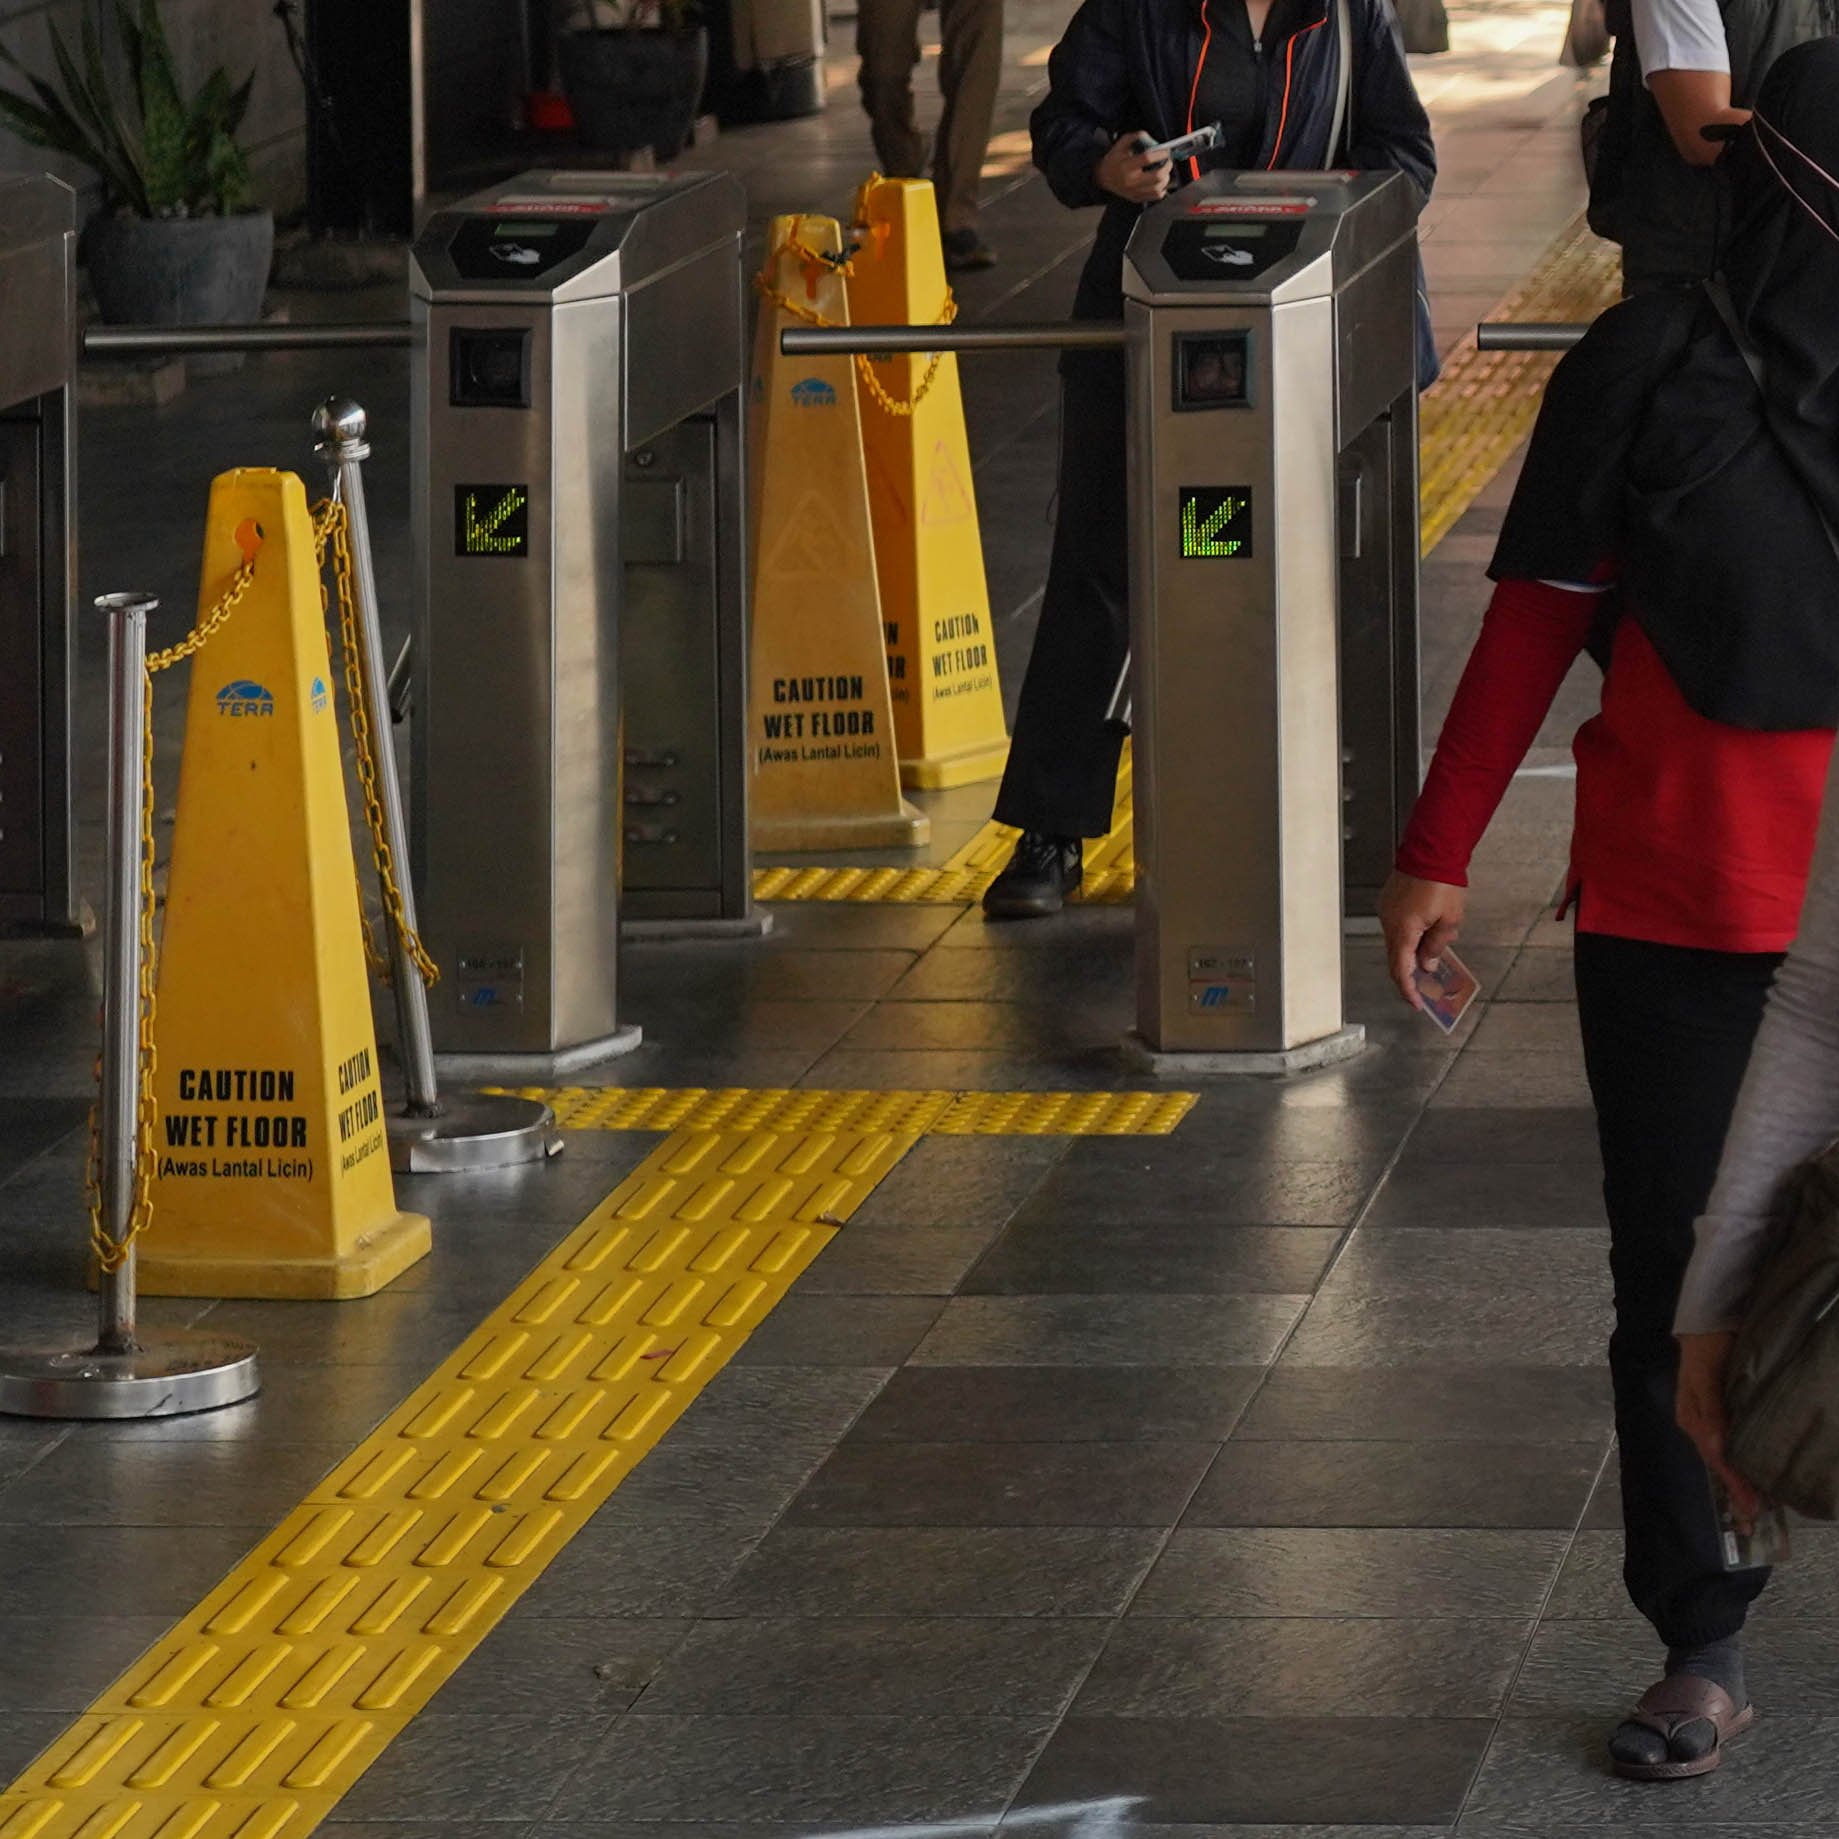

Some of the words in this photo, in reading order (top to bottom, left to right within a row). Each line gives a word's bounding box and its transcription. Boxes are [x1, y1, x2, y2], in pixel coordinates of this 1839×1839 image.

[935, 613, 979, 642] CAUTION
[932, 652, 951, 677] WET
[957, 644, 987, 673] FLOOR
[773, 676, 862, 703] CAUTION
[217, 702, 273, 716] TERA
[764, 714, 804, 738] WET
[812, 711, 874, 737] FLOOR
[759, 747, 798, 765] (Awas
[845, 743, 880, 761] Licin)
[180, 1070, 294, 1101] CAUTION
[338, 1048, 371, 1095] CAUTION
[338, 1106, 354, 1143] WET
[355, 1090, 378, 1132] FLOOR
[166, 1116, 218, 1147] WET
[227, 1117, 307, 1147] FLOOR
[158, 1159, 207, 1181] (Awas
[268, 1159, 313, 1182] Licin)
